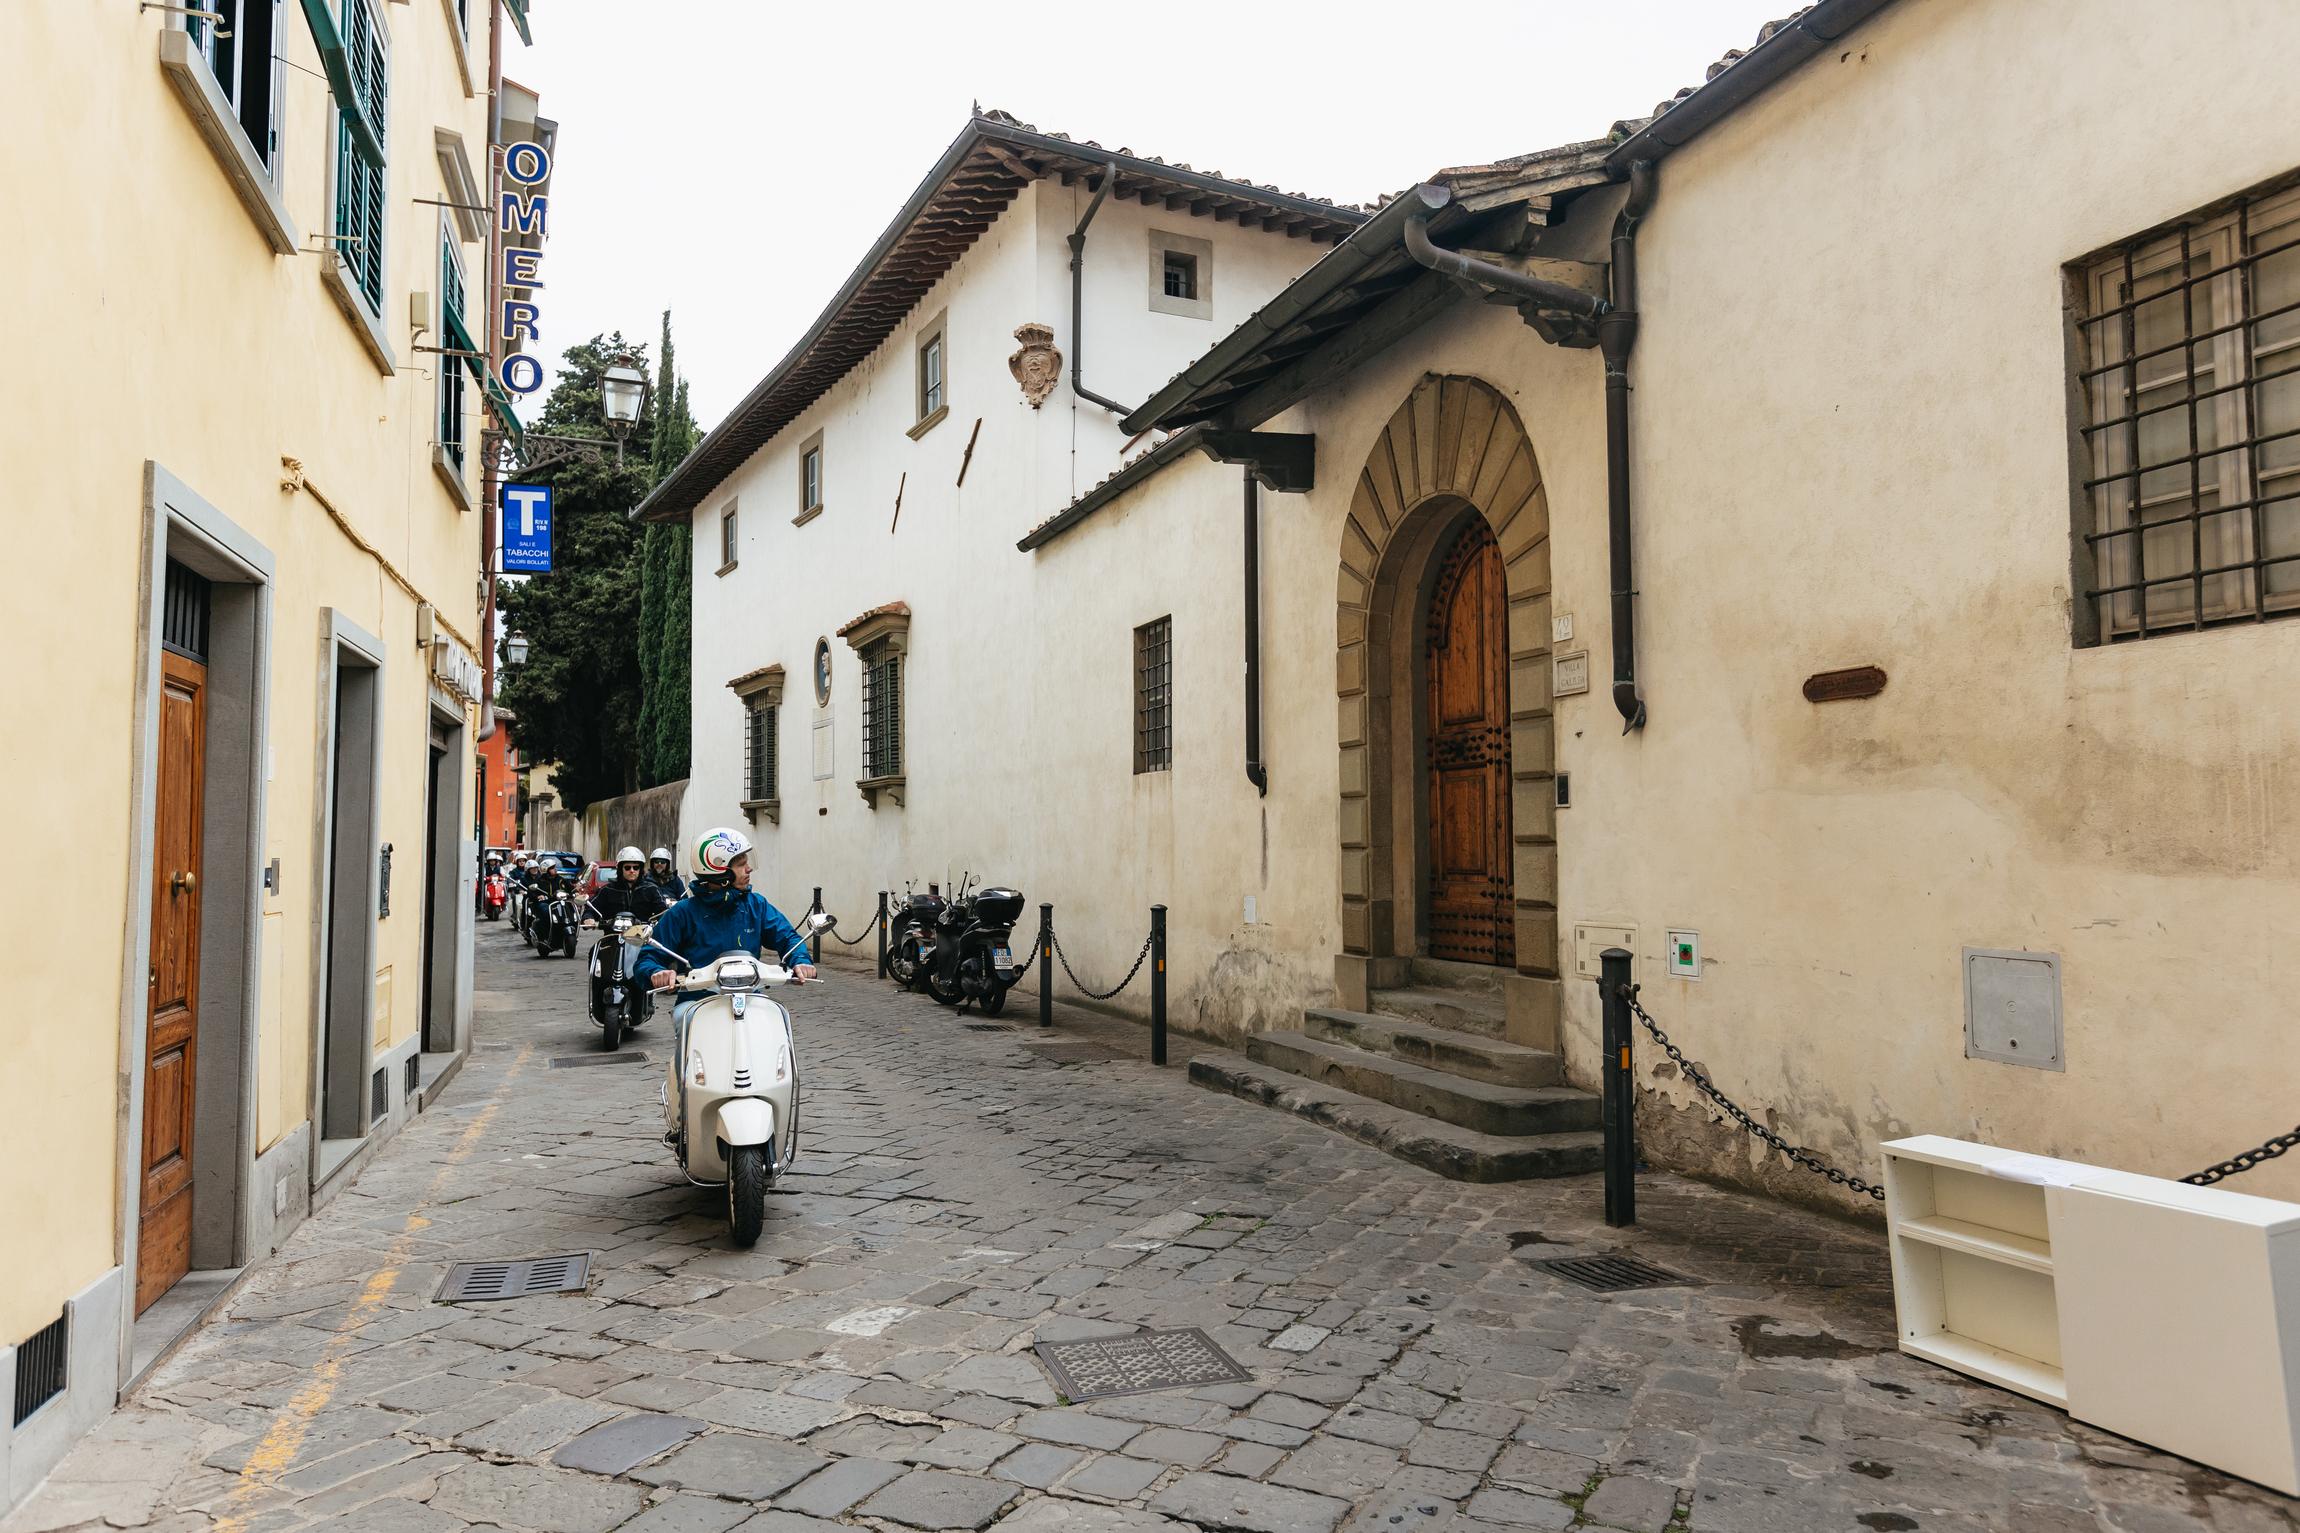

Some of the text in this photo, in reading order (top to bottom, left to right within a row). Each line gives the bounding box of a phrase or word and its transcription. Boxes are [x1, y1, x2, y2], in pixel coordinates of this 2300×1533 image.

[500, 141, 551, 396] OMERO
[508, 490, 546, 536] T
[506, 548, 549, 558] TABACCHI
[1564, 662, 1580, 673] VILLA
